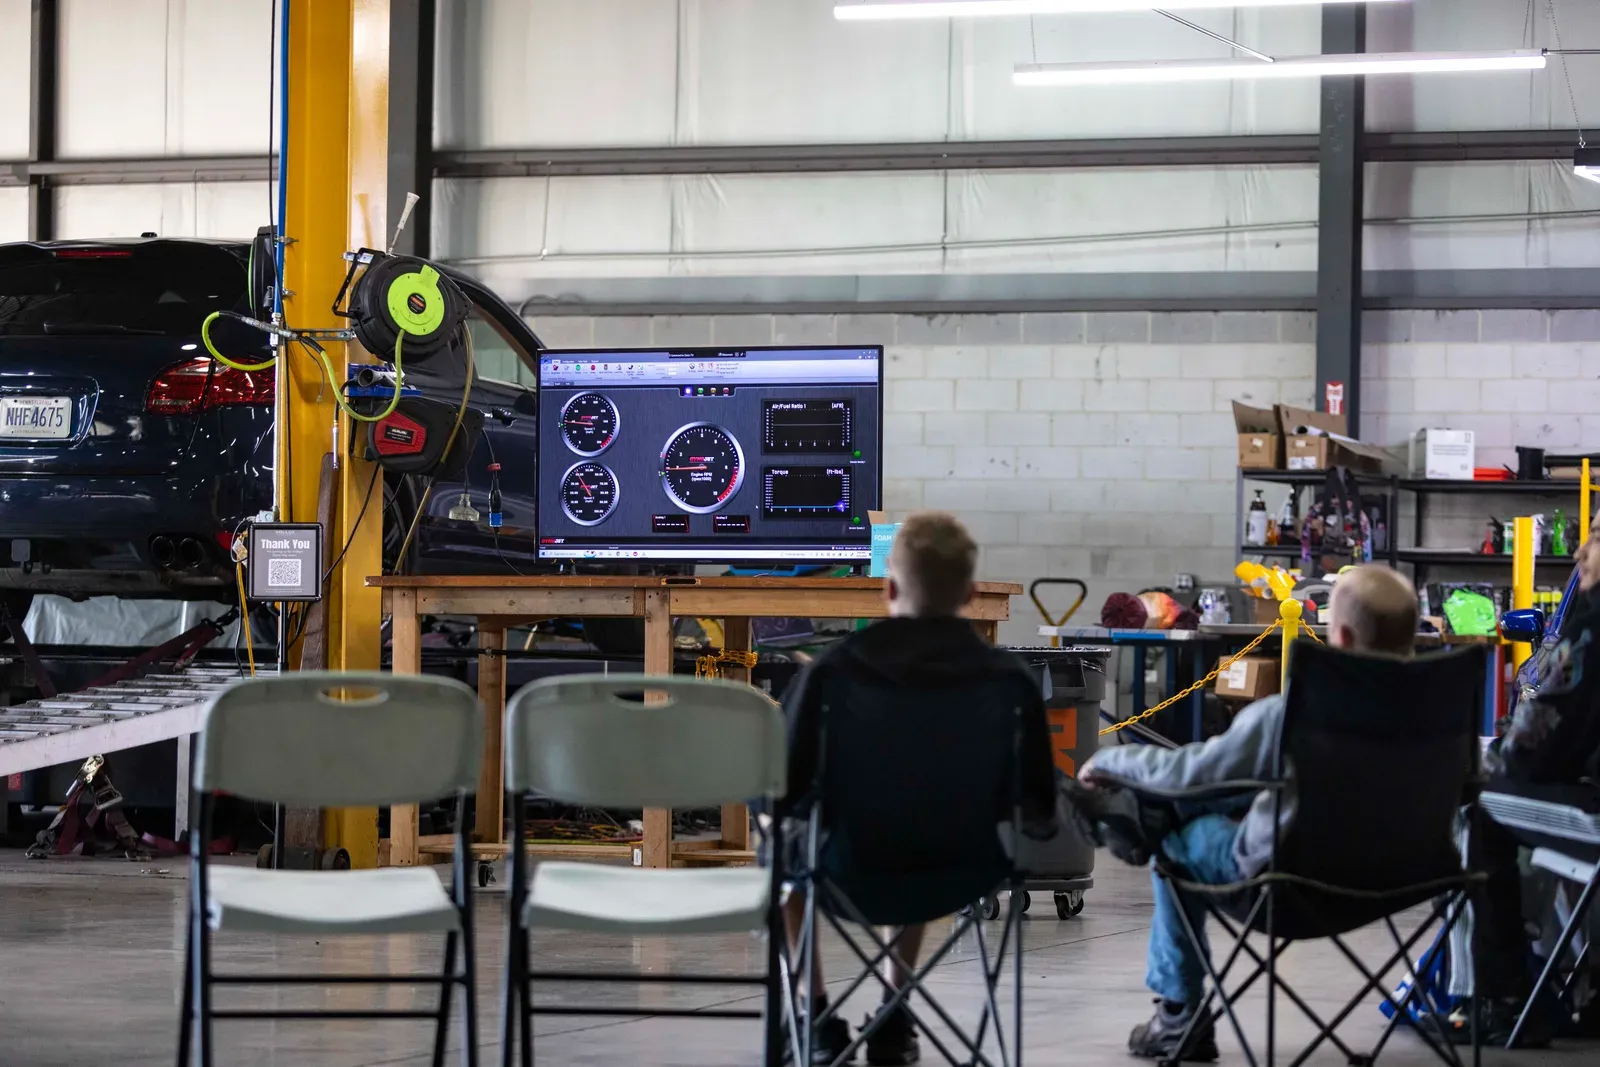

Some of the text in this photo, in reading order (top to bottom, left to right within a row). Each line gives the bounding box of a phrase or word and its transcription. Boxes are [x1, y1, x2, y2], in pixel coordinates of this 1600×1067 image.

[6, 406, 64, 427] NHF4675
[261, 539, 310, 549] Thank You
